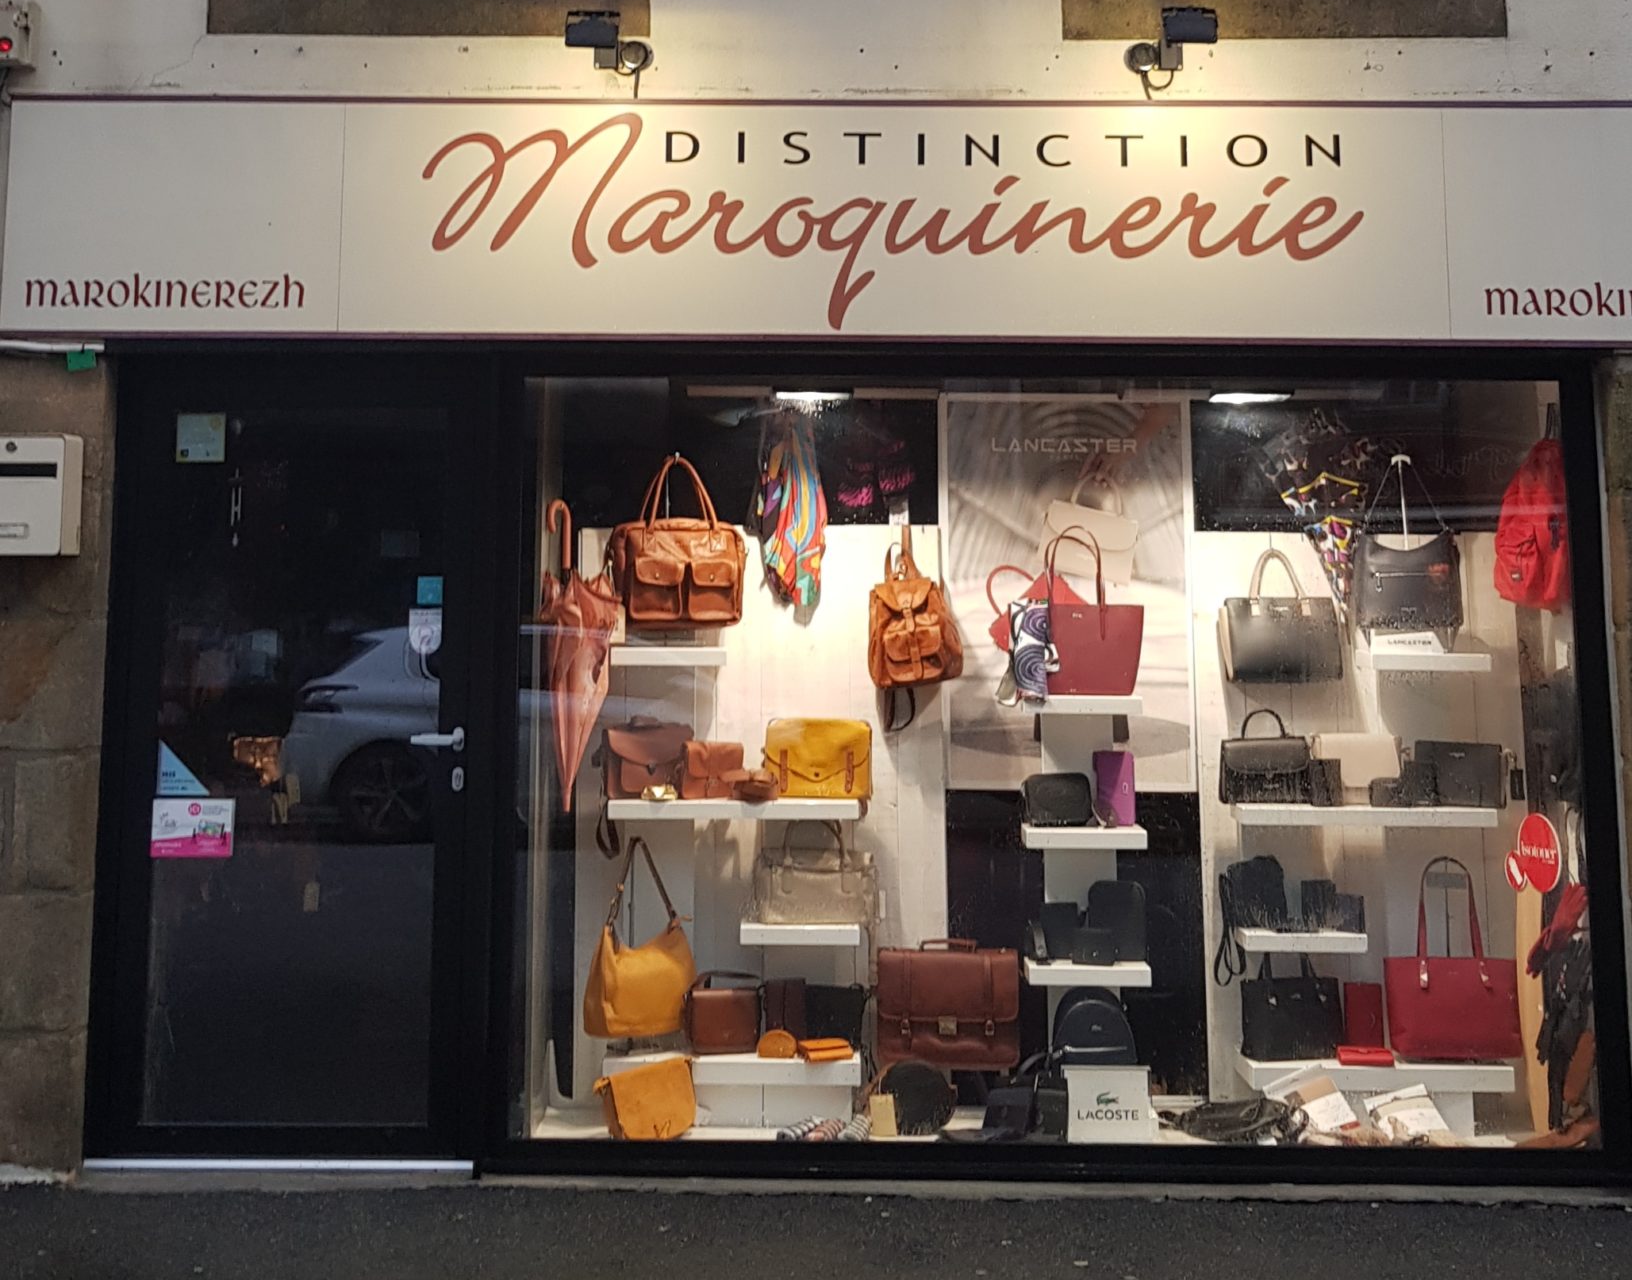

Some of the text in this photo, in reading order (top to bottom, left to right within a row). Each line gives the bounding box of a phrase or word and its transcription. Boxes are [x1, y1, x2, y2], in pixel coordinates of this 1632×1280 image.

[666, 130, 1341, 168] DISTINCTION
[422, 113, 1364, 330] Maroquinerie
[991, 437, 1138, 453] LANCASTER
[1077, 1109, 1139, 1121] LACOSTE
